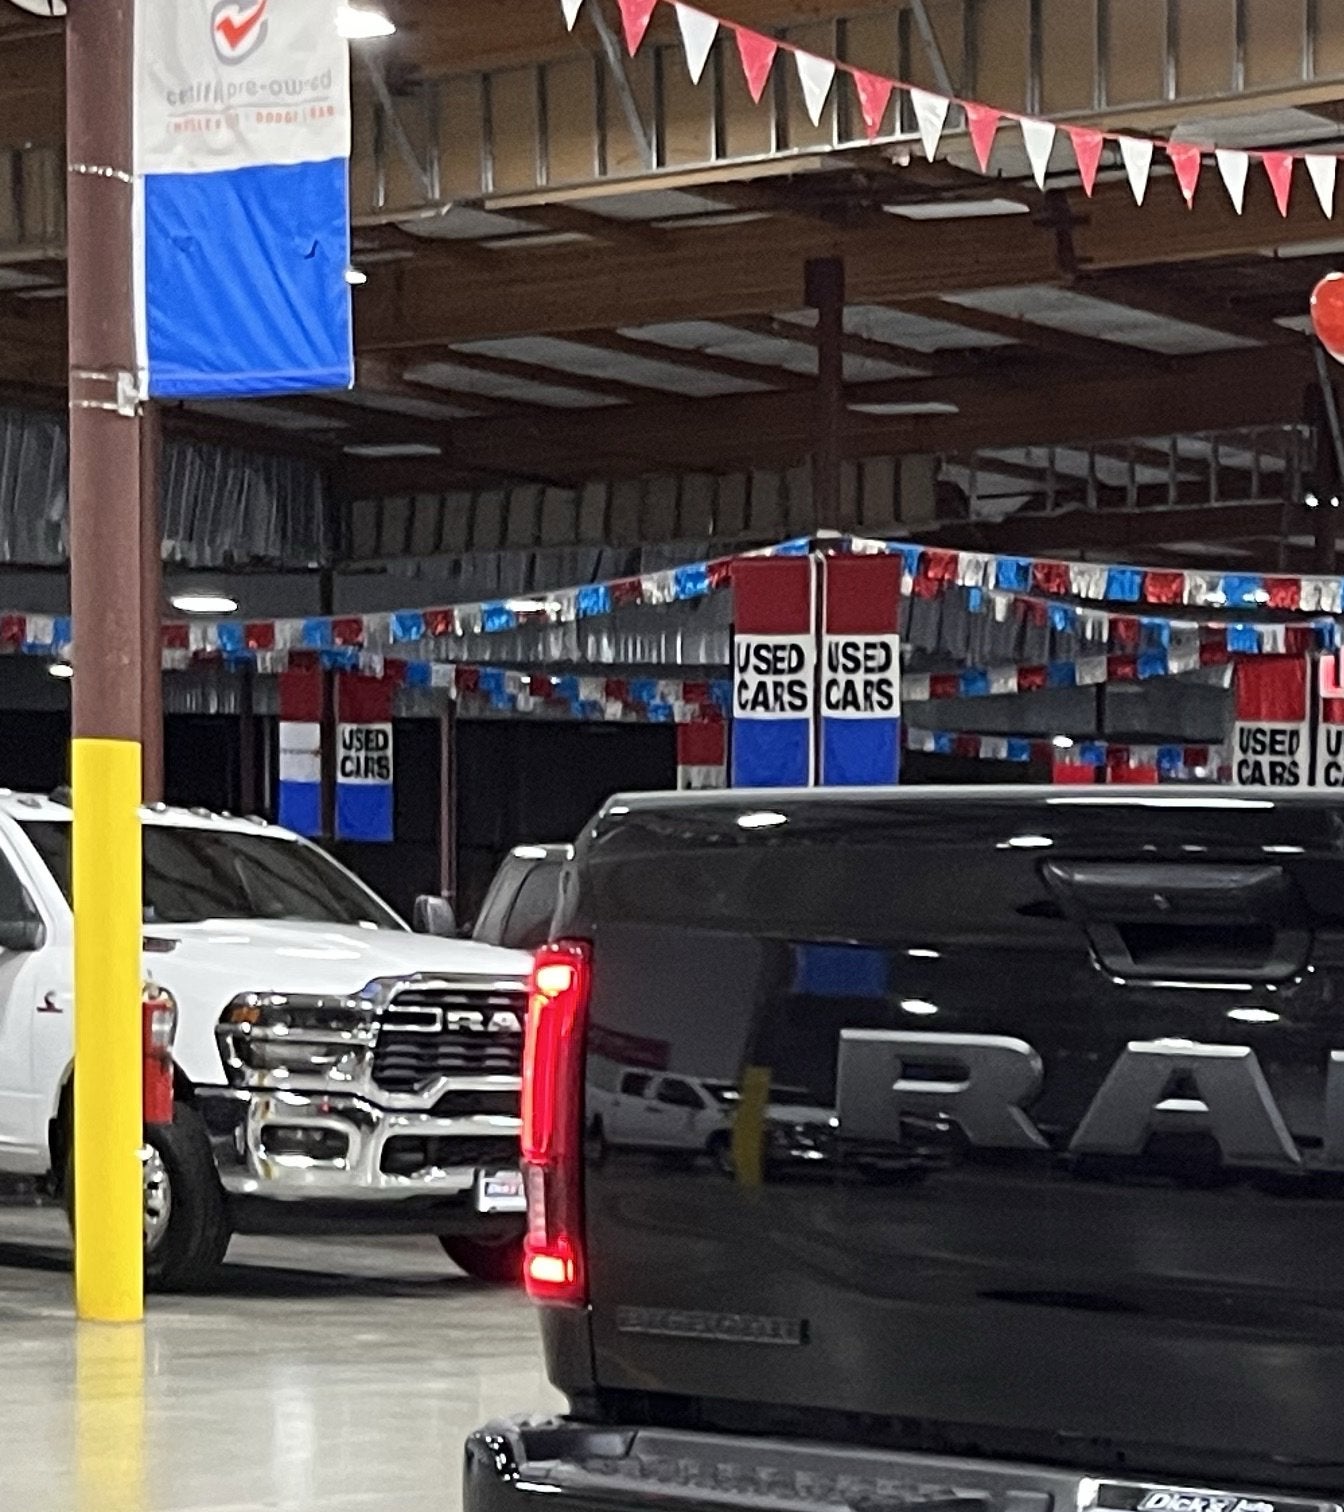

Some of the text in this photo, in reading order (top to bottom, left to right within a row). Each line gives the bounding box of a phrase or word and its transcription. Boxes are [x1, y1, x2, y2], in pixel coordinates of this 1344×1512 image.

[737, 643, 805, 675] USED
[828, 641, 892, 674] USED
[737, 678, 807, 711] CARS
[825, 678, 894, 711] CARS
[342, 728, 389, 752] USED
[1239, 727, 1299, 755] USED
[341, 756, 390, 779] CARS
[1238, 759, 1299, 786] CARS
